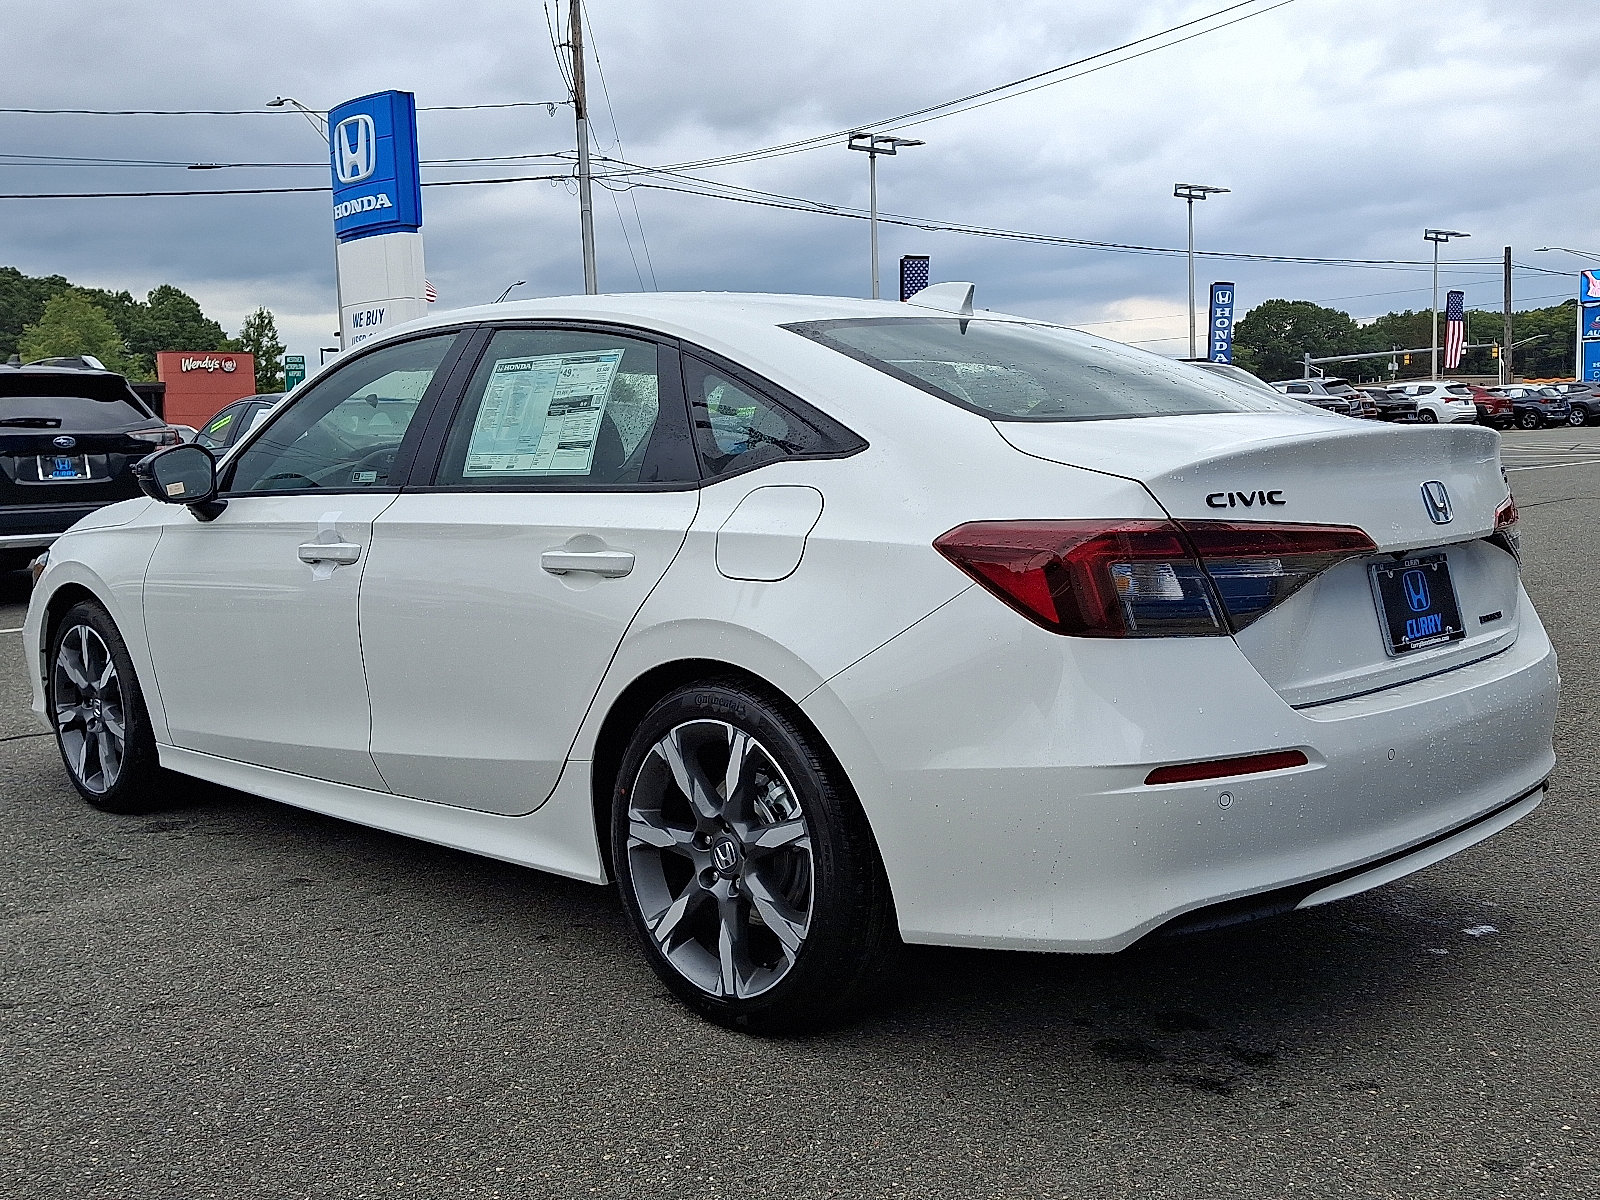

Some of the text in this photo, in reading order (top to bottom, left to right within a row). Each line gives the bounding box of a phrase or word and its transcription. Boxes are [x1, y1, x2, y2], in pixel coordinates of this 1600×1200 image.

[334, 193, 393, 220] HONDA
[352, 307, 385, 329] WE BUY
[1214, 307, 1231, 362] HONDA
[181, 355, 220, 373] Wendy's
[504, 363, 532, 371] HONDA
[1206, 490, 1287, 508] CIVIC
[1406, 613, 1442, 639] CURRY
